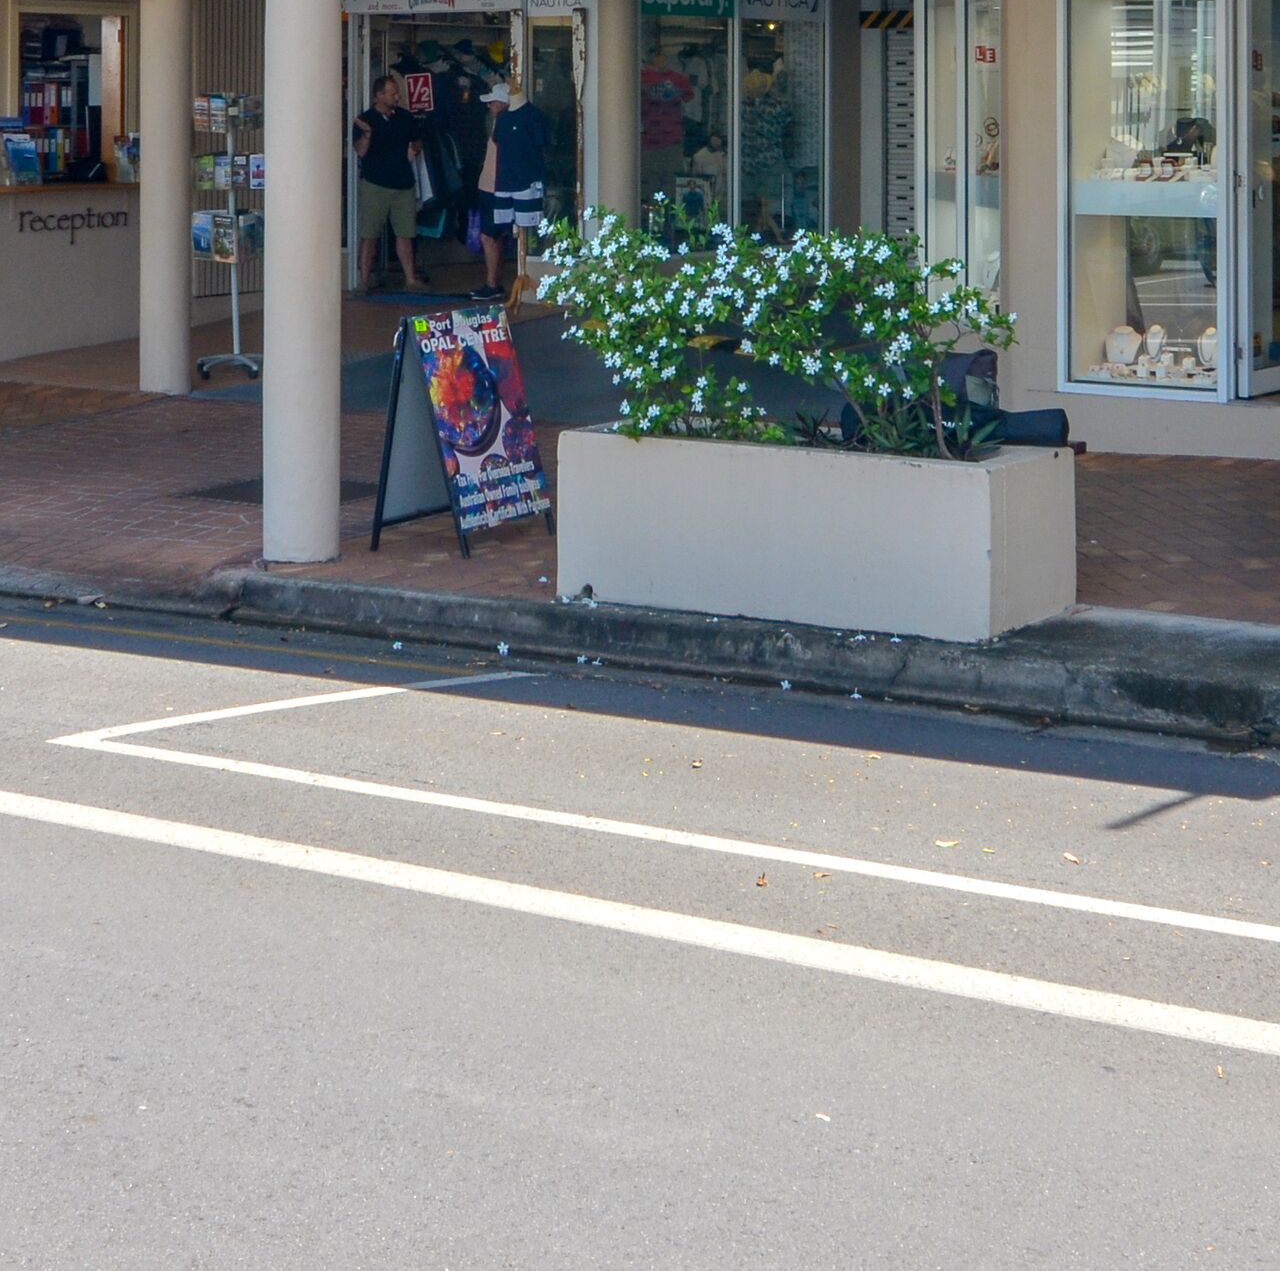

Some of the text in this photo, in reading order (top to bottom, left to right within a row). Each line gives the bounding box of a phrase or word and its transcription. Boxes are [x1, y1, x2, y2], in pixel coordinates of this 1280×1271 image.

[19, 207, 128, 245] reception
[429, 319, 451, 330] Port
[421, 328, 507, 353] OPAL CENTRE
